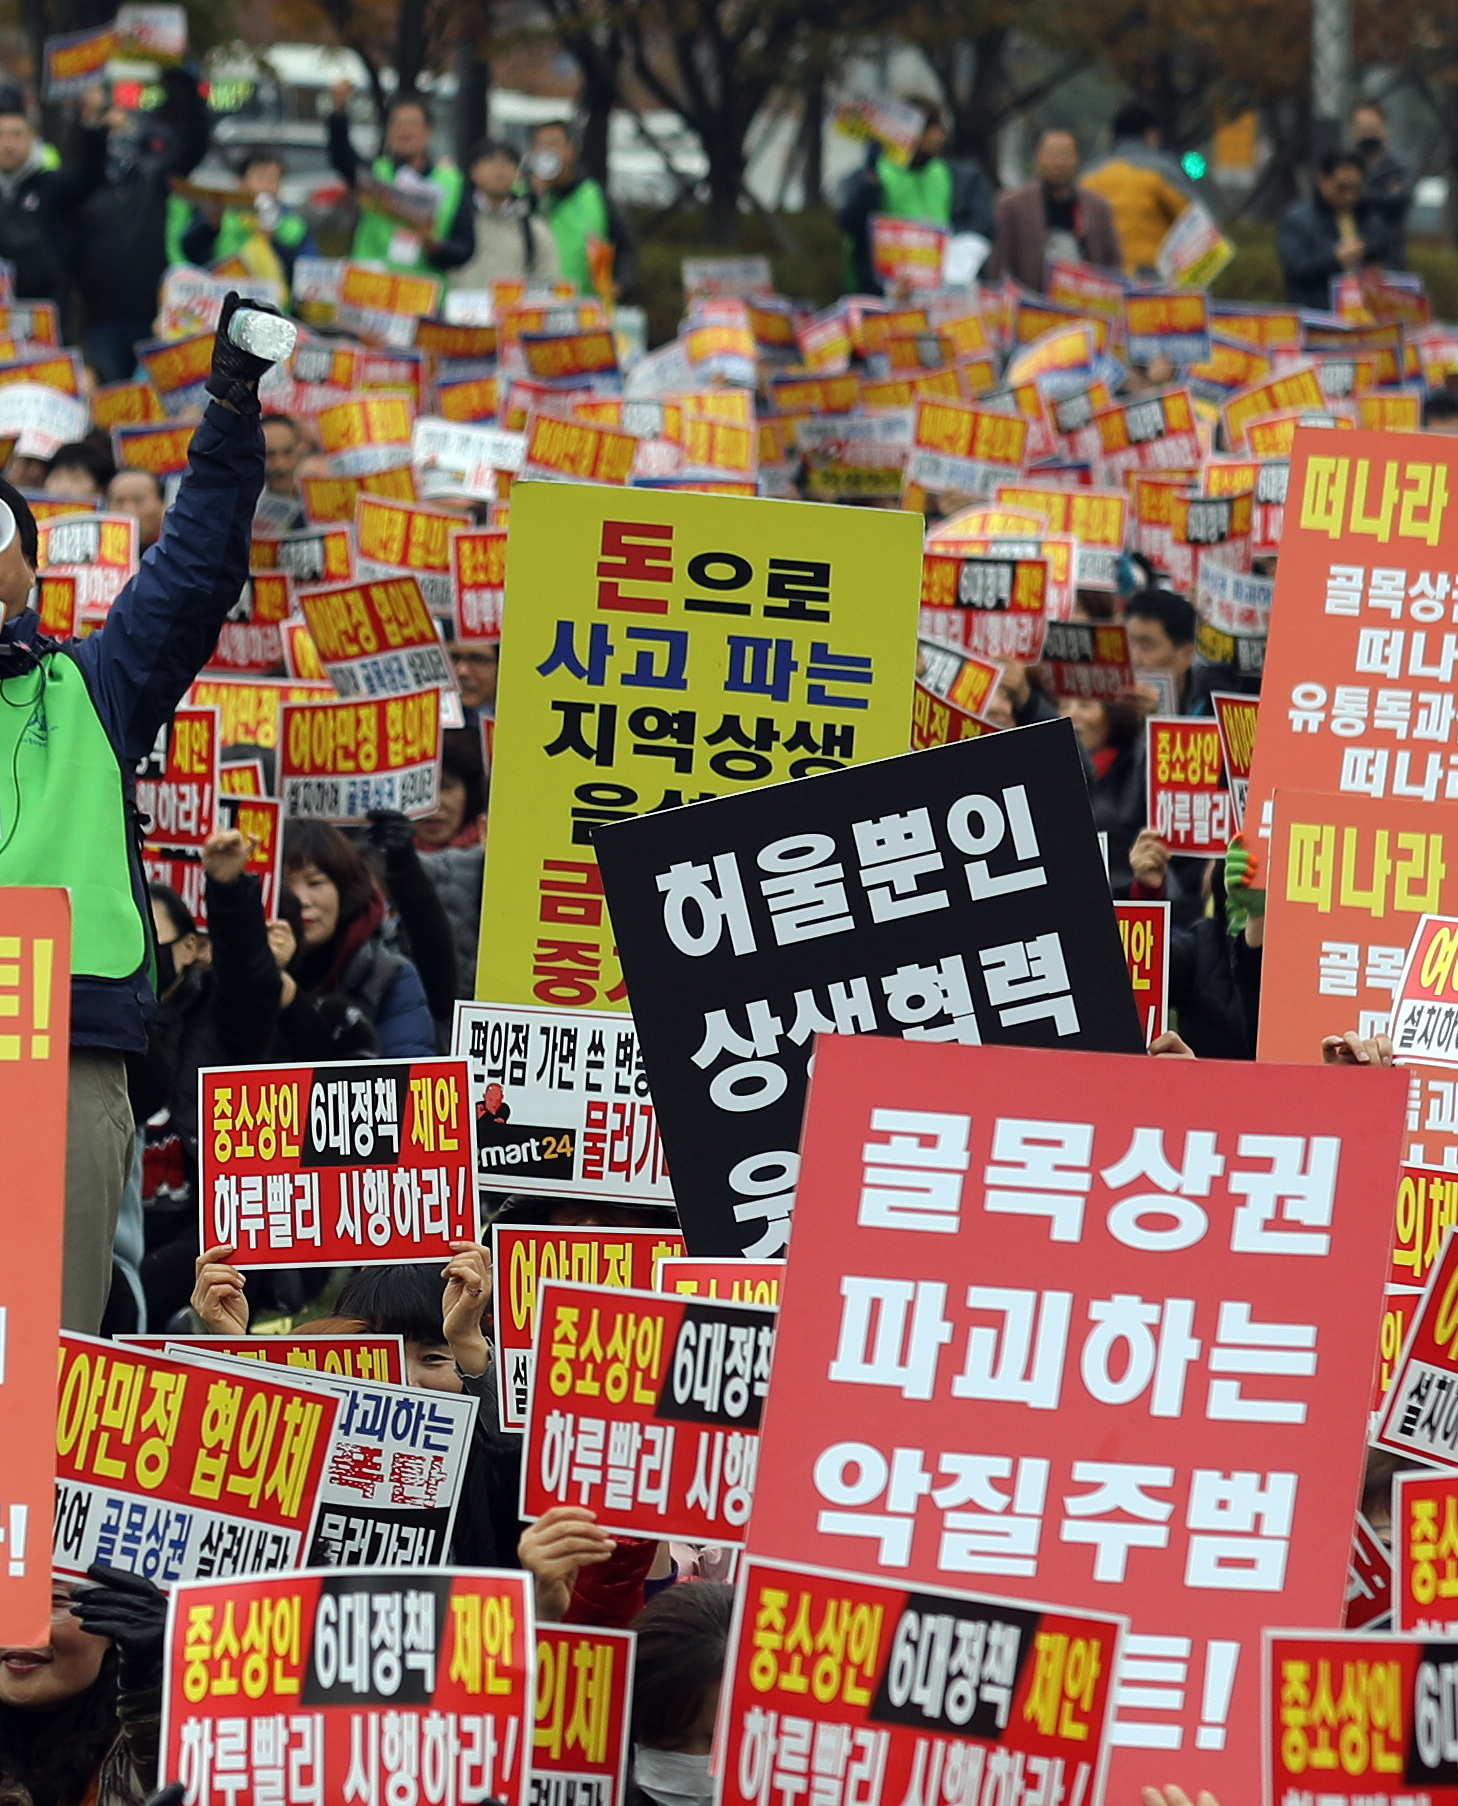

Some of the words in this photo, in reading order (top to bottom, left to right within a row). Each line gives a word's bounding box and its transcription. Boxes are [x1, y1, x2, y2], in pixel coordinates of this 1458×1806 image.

[1298, 455, 1449, 549] 떠나라
[595, 520, 833, 624] 돈으로
[536, 619, 689, 695] 사고
[722, 634, 873, 709] 파는
[288, 708, 379, 774] 여야민정
[382, 690, 438, 762] 협의체
[545, 699, 855, 783] 지역상생
[1155, 730, 1220, 792] 중소상인
[655, 783, 1048, 958] 허울뿐인
[1157, 794, 1230, 856] 하루빨리
[1287, 822, 1447, 918] 떠나라
[471, 1023, 529, 1084] 편의점
[537, 1027, 578, 1091] 가면
[585, 1030, 608, 1083] 쓴
[214, 1088, 300, 1163] 중소상인
[311, 1076, 399, 1158] 6대정책
[409, 1075, 460, 1155] 제안
[213, 1172, 322, 1252] 하루빨리
[336, 1164, 466, 1248] 시행하라!
[856, 1107, 1343, 1257] 골목상권
[550, 1308, 665, 1402] 중소상인
[828, 1274, 1318, 1424] 파괴하는
[191, 1380, 326, 1520] 협의체
[543, 1410, 666, 1517] 하루빨리
[813, 1439, 1299, 1592] 악질주범
[182, 1594, 300, 1703] 중소상인
[313, 1591, 438, 1696] 6대정책
[449, 1593, 513, 1696] 제안
[749, 1586, 884, 1707] 중소상인
[887, 1610, 1022, 1729] 6대정책
